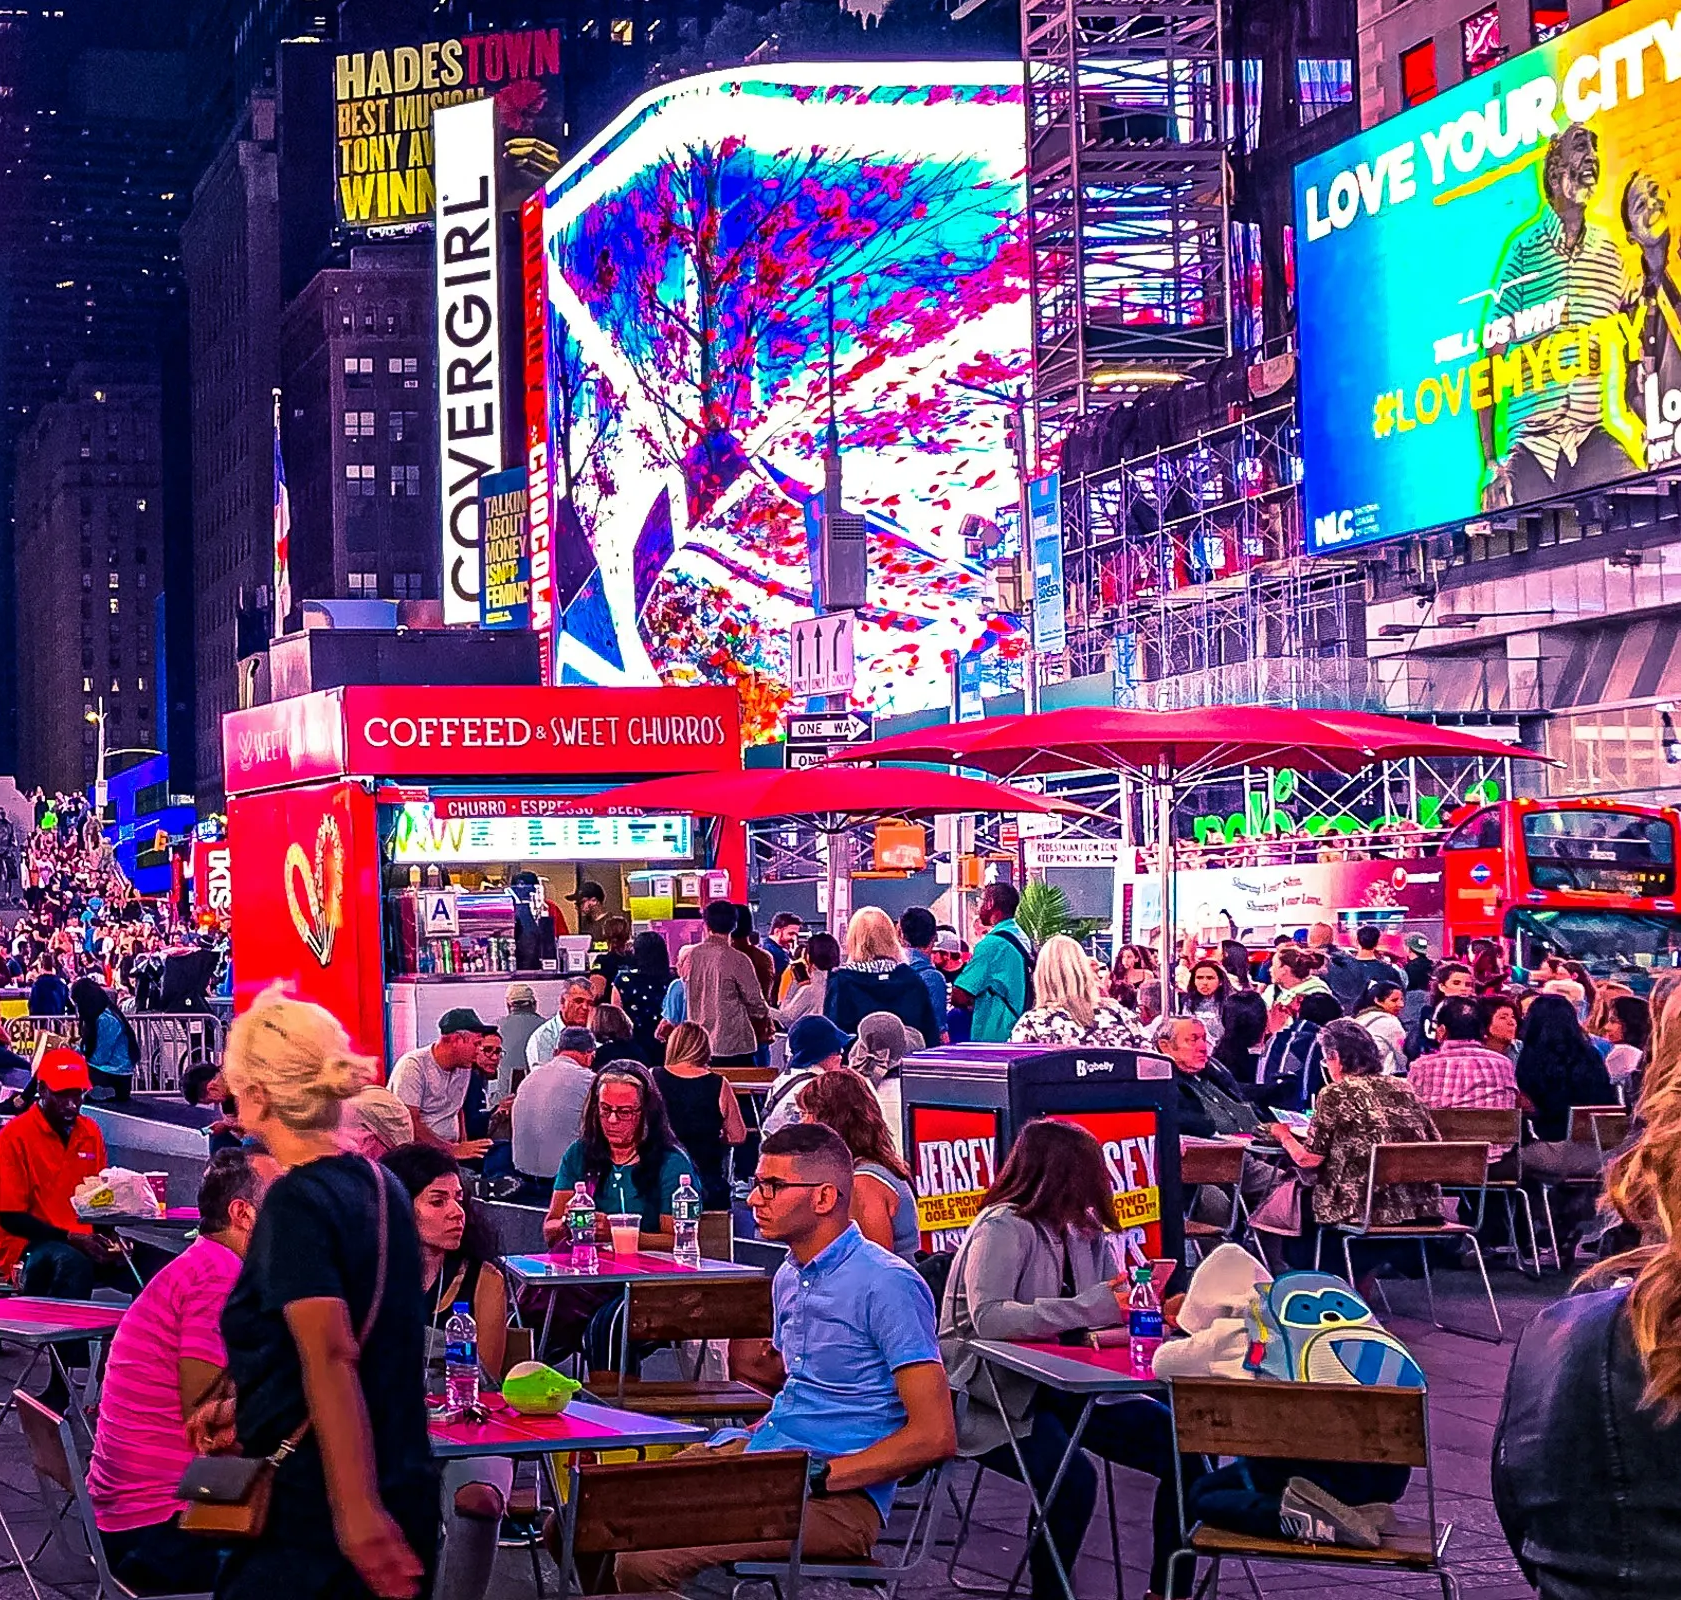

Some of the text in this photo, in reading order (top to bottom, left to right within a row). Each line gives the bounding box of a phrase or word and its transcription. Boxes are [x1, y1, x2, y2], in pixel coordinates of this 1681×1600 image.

[337, 98, 390, 138] BEST
[1305, 9, 1681, 243] LOVE YOUR CITY
[339, 133, 403, 175] TONY
[444, 173, 496, 604] COVERGIRL
[485, 512, 527, 542] ABOUT
[1315, 509, 1356, 547] NLC
[485, 534, 528, 564] MONEY
[793, 672, 851, 693] ONLY ONLY ONLY
[363, 717, 532, 748] COFFEED
[535, 725, 548, 740] &
[551, 715, 620, 747] SWEET
[627, 714, 726, 746] CHURROS
[797, 722, 860, 735] ONE WAY
[253, 729, 286, 764] SWEET
[447, 800, 507, 818] CHURRO
[1037, 842, 1079, 852] PEDESTRIAN
[1080, 843, 1099, 852] FLOW
[430, 898, 451, 921] A
[1076, 1060, 1115, 1077] Bigbelly
[916, 1137, 997, 1197] JERSEY
[1101, 1135, 1158, 1195] SEY
[925, 1204, 981, 1223] GOES WIL
[947, 1193, 985, 1210] CROW
[1114, 1193, 1149, 1210] OWD
